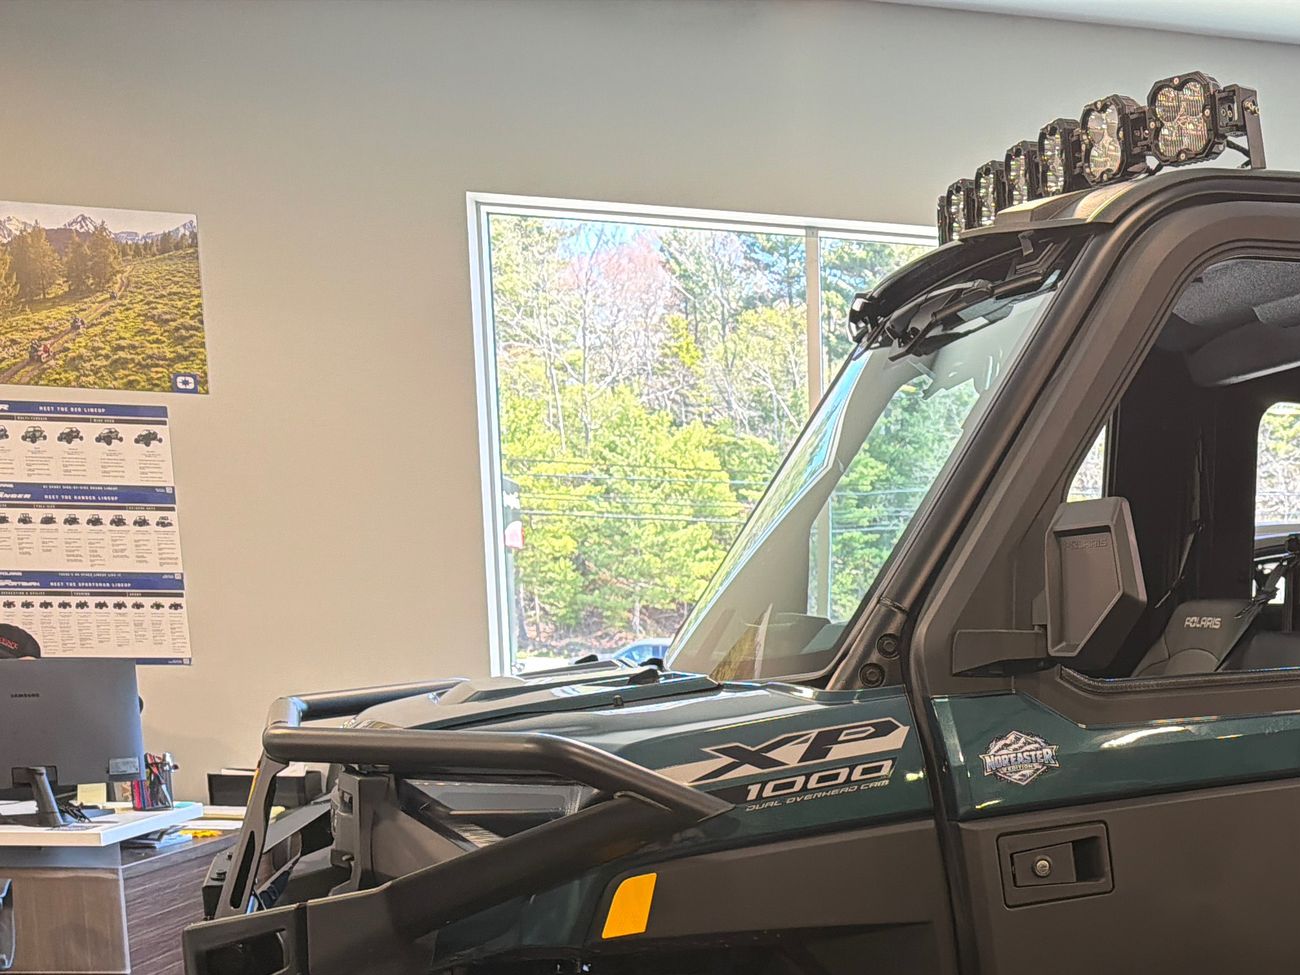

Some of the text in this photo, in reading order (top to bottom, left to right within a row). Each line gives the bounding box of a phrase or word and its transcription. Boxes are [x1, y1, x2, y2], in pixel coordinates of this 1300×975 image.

[1184, 616, 1221, 629] POLARIS
[688, 718, 901, 784] XP
[746, 759, 894, 800] 1000
[746, 779, 889, 812] DUAL OVERHEAD CAM
